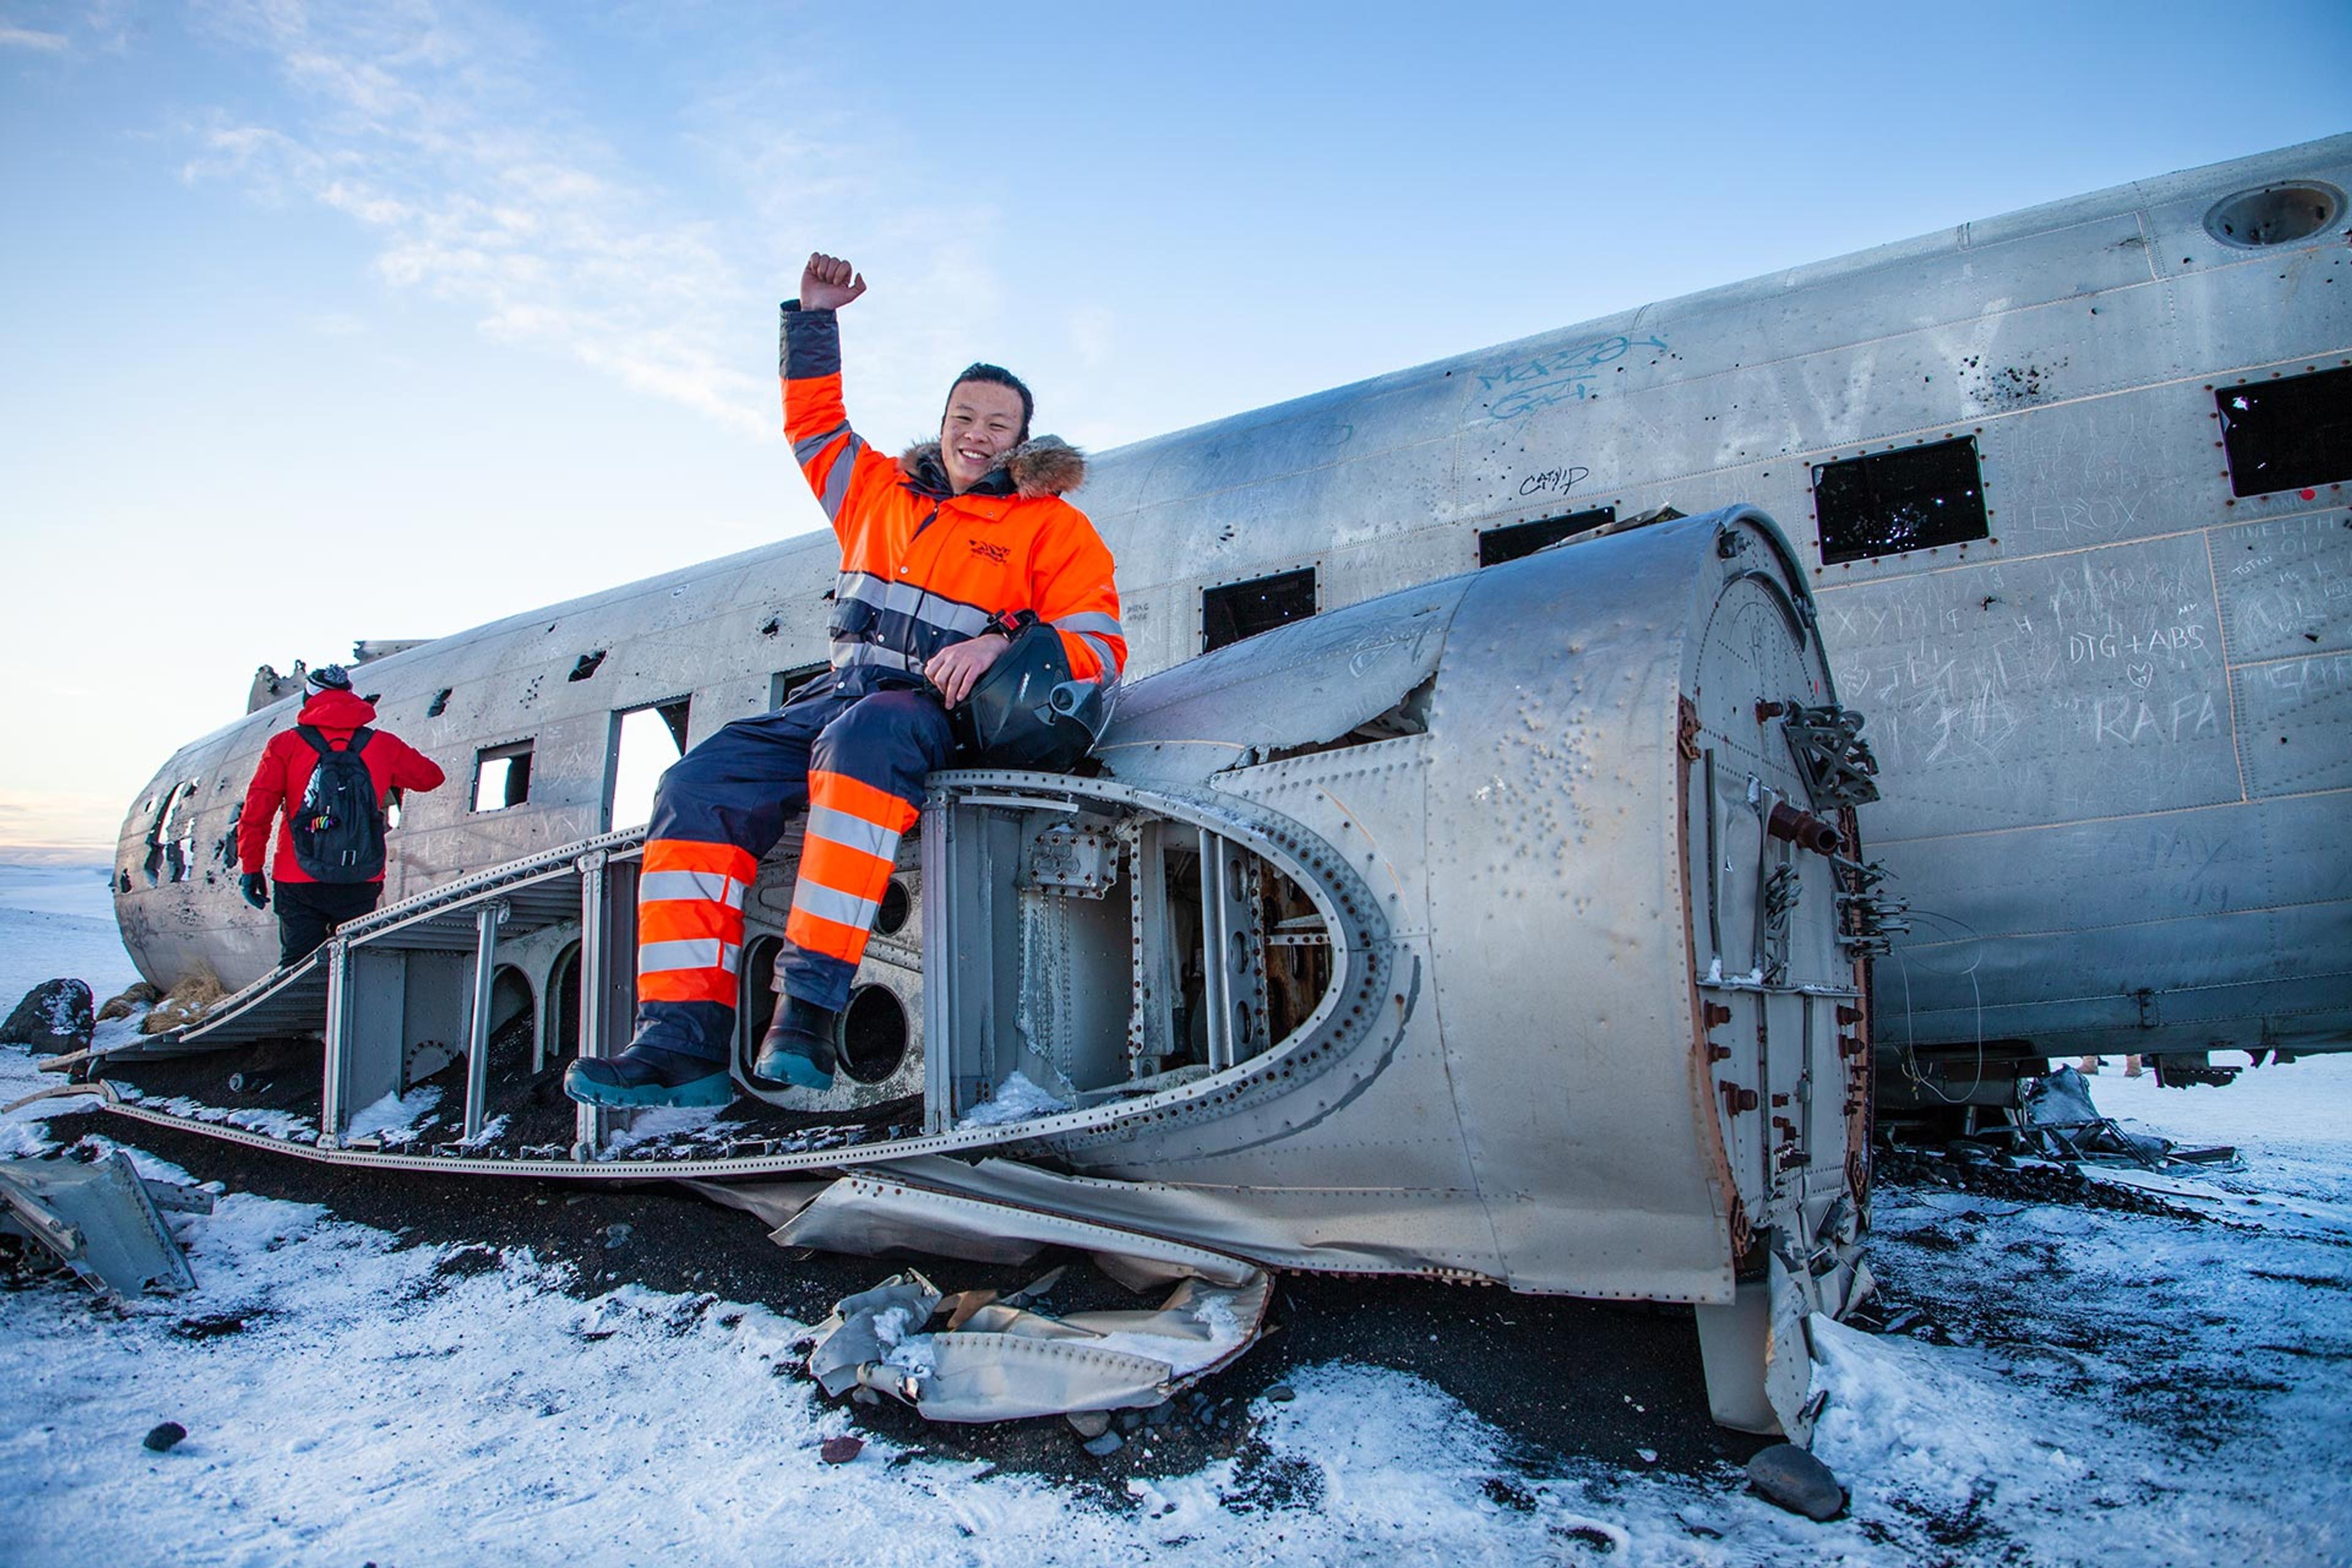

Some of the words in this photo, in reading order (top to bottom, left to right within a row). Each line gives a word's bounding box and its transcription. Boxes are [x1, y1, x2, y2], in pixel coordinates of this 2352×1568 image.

[2070, 632, 2116, 664] DTG
[2149, 624, 2205, 652] ABS
[2095, 692, 2220, 745] RAFA
